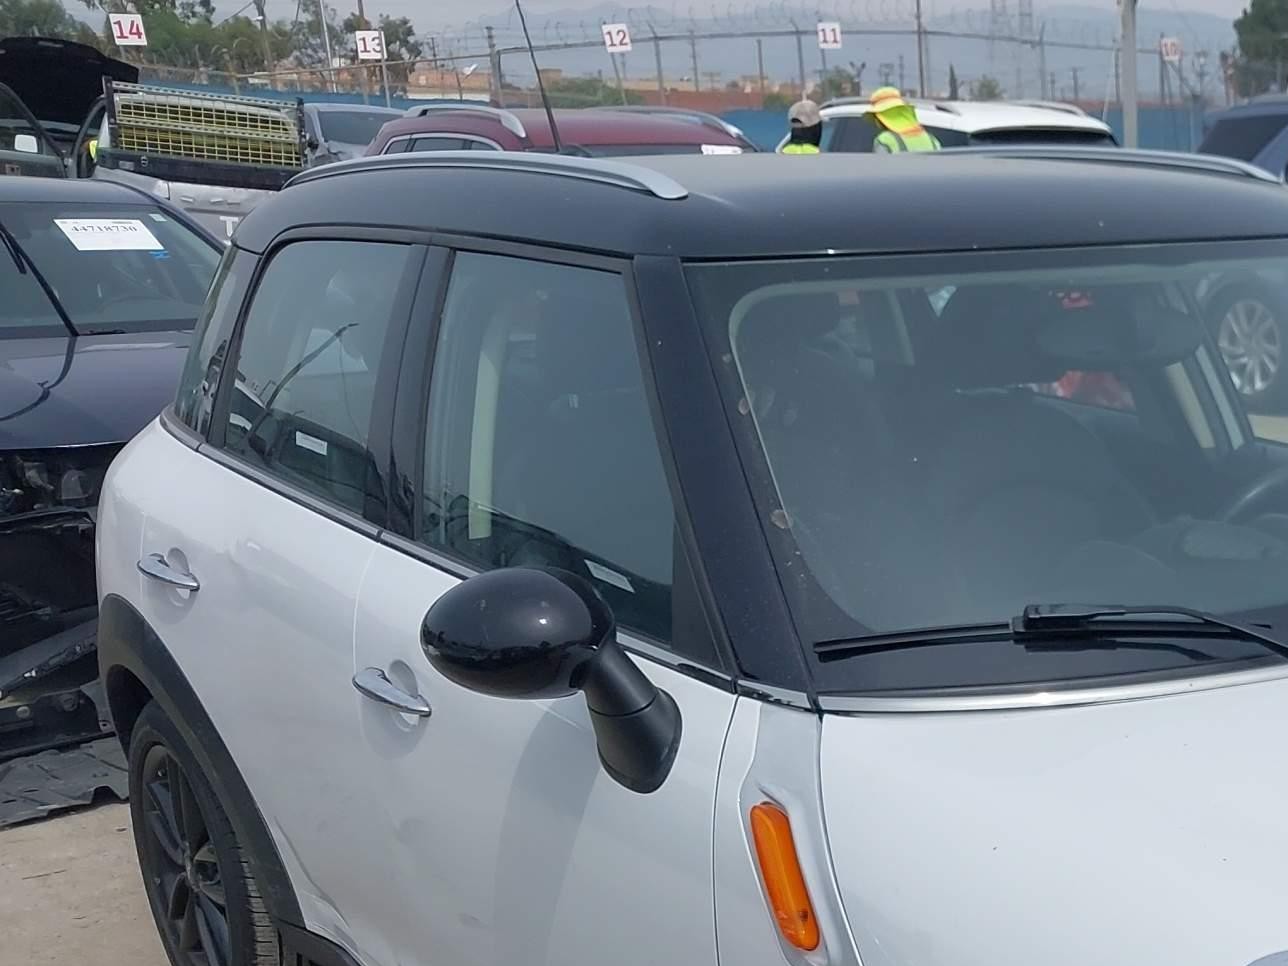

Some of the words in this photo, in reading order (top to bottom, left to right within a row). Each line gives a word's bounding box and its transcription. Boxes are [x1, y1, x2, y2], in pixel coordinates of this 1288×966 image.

[113, 20, 143, 39] 14
[605, 29, 628, 46] 12
[821, 28, 839, 43] 11
[359, 36, 382, 53] 13
